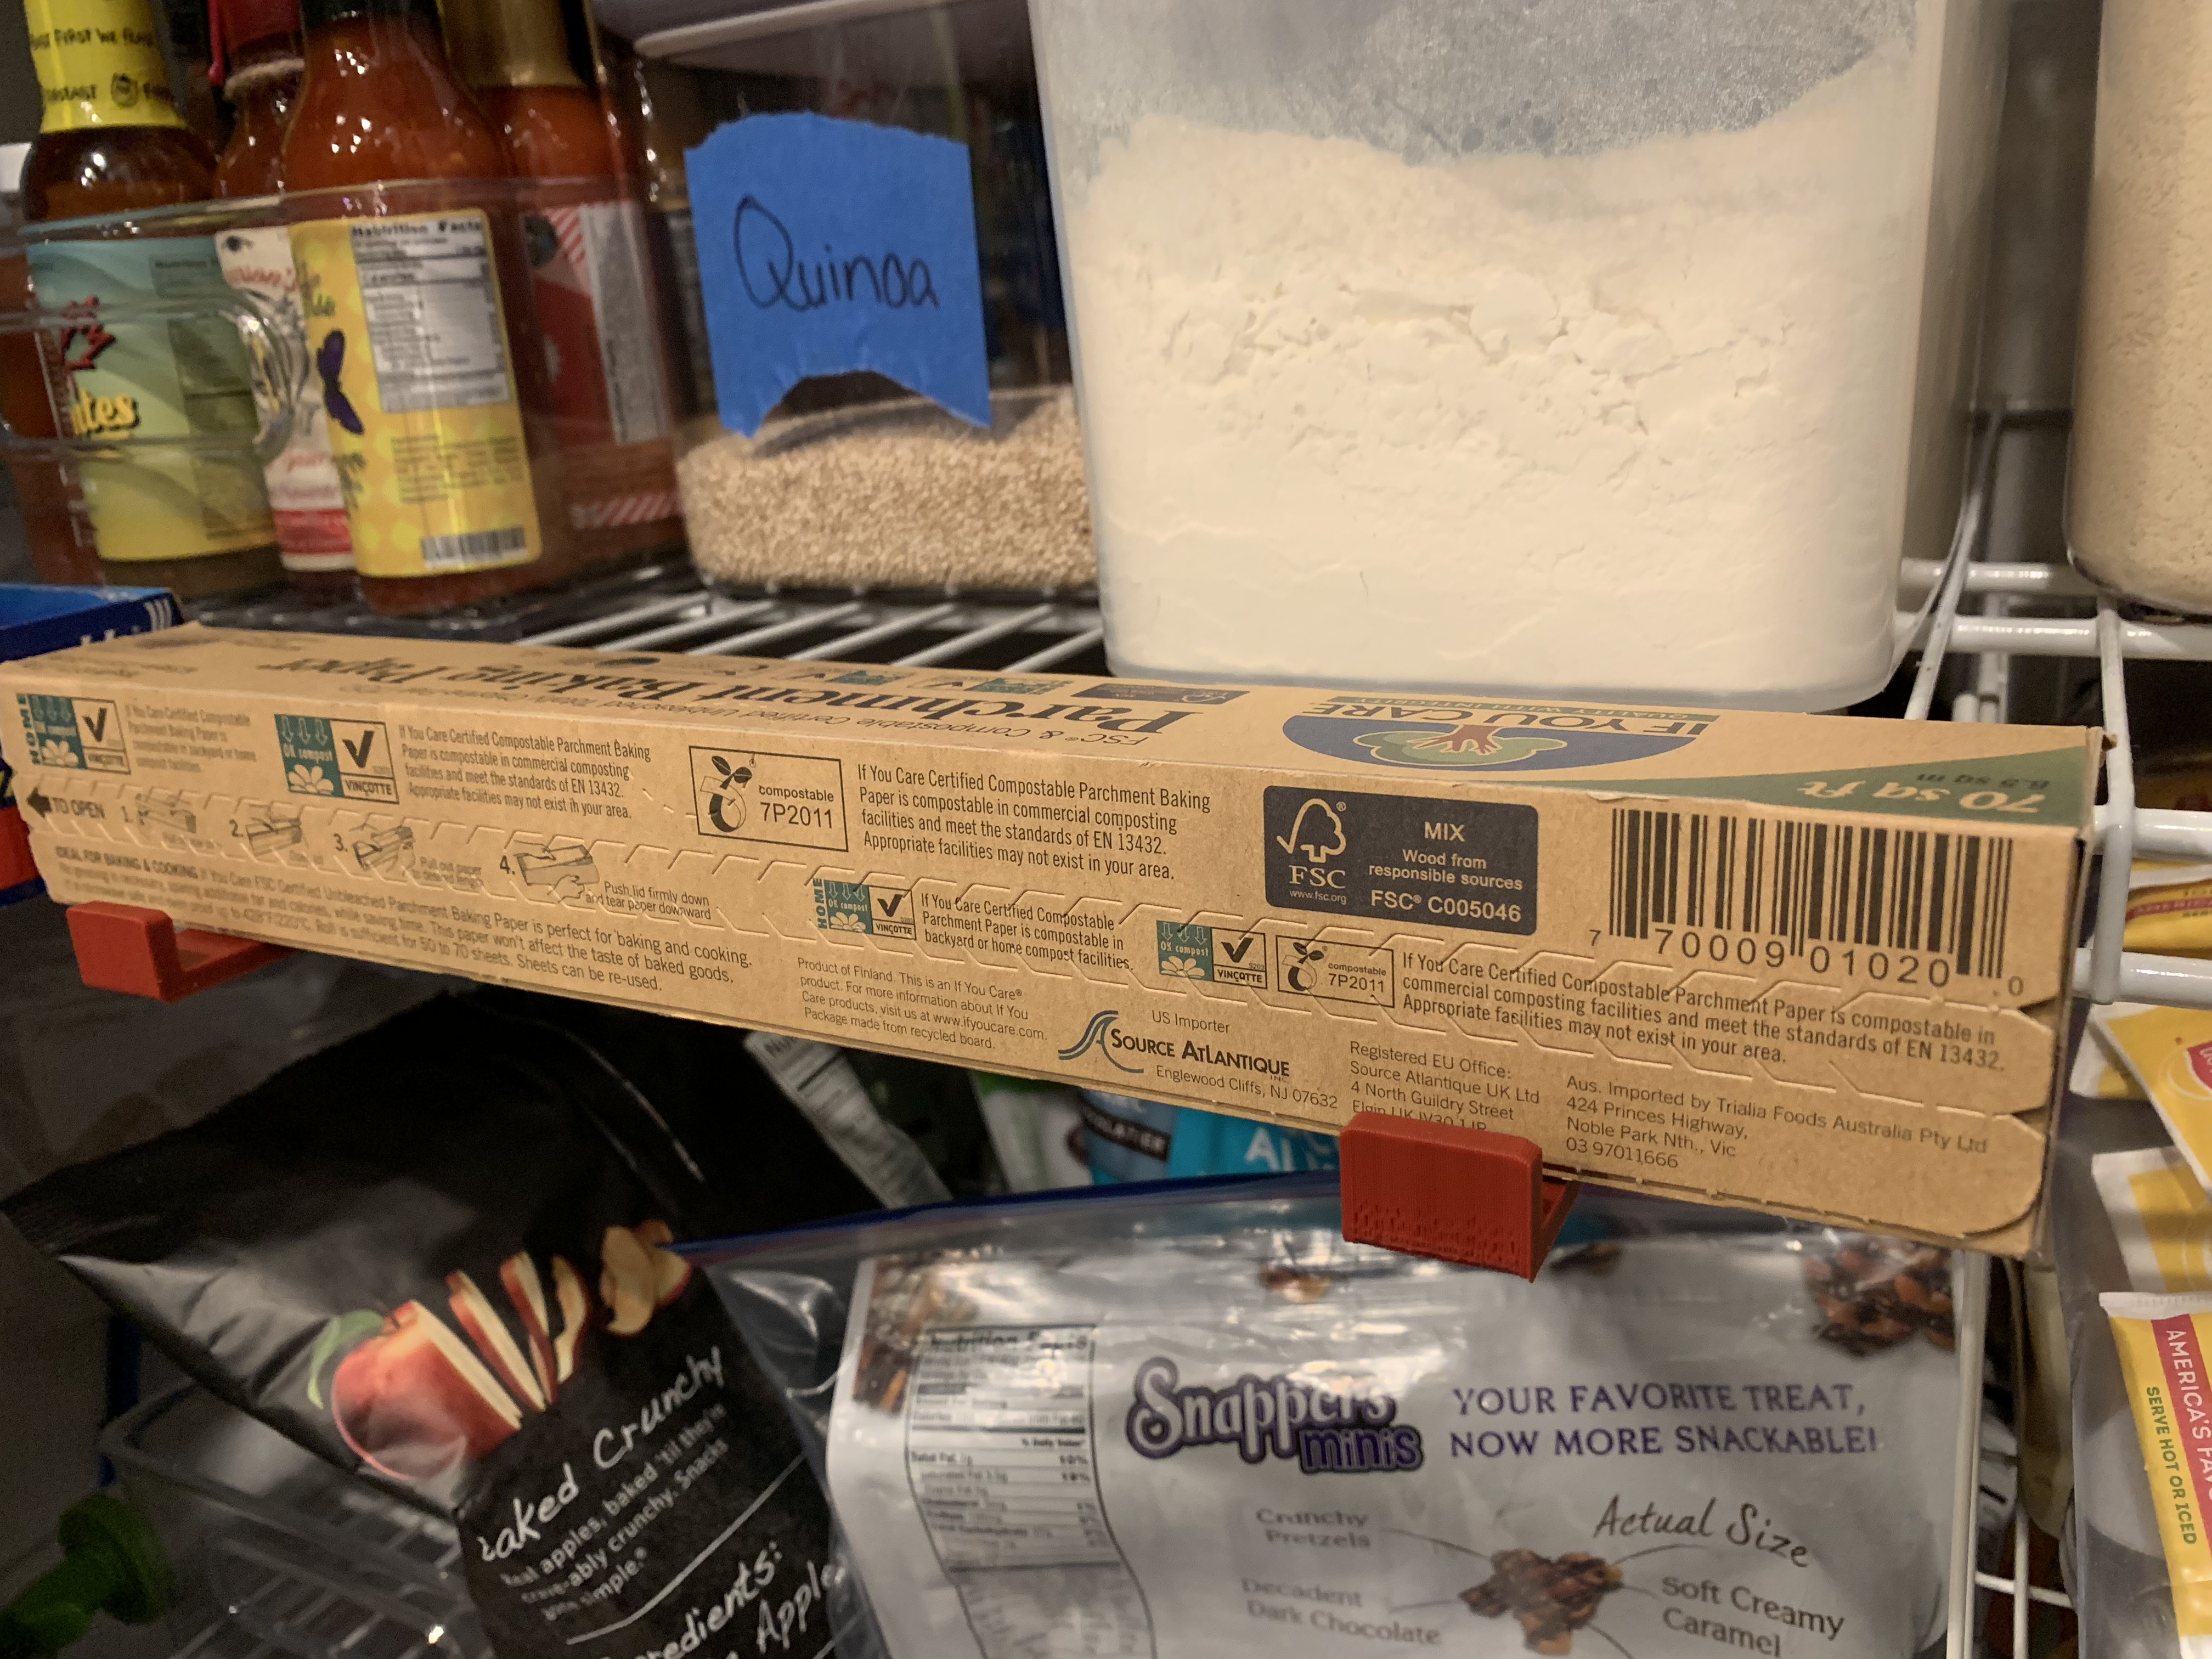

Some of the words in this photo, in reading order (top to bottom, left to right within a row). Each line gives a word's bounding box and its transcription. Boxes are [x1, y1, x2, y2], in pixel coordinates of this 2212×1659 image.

[733, 193, 939, 313] Quinoa
[256, 657, 450, 684] Paper
[439, 665, 706, 702] Baking
[693, 684, 1201, 734] Parchment
[1354, 697, 1483, 709] INTEGRITY
[1494, 704, 1559, 713] WITH
[1577, 708, 1689, 719] QUALITY
[745, 710, 851, 725] Certified
[856, 718, 1031, 737] Compostable
[1487, 714, 1631, 731] YOU
[1640, 719, 1708, 735] IF
[1040, 730, 1063, 740] &
[758, 785, 834, 802] compostable
[857, 763, 867, 781] If
[868, 764, 893, 783] You
[895, 766, 926, 787] Care
[927, 768, 985, 792] Certified
[988, 773, 1076, 799] Compostable
[1078, 781, 1156, 806] Parchment
[1159, 787, 1211, 815] Baking
[1796, 779, 1868, 798] ft
[1874, 780, 1951, 803] sq
[1959, 790, 2047, 814] 70
[52, 797, 67, 814] TO
[70, 799, 105, 819] OPEN
[760, 802, 833, 829] 7P2011
[859, 785, 896, 808] Paper
[897, 788, 910, 808] is
[911, 794, 995, 815] compostable
[996, 797, 1010, 817] in
[1012, 803, 1091, 825] commercial
[1094, 810, 1178, 836] composting
[229, 819, 244, 839] 2.
[333, 833, 348, 853] 3.
[860, 807, 916, 831] facilities
[917, 815, 942, 833] and
[945, 819, 978, 837] meet
[979, 819, 1002, 839] the
[1005, 822, 1073, 846] standards
[1075, 829, 1090, 848] of
[1092, 830, 1113, 850] EN
[1118, 832, 1167, 856] 13432.
[1424, 821, 1466, 843] MIX
[499, 855, 515, 875] 4.
[863, 830, 936, 855] Appropriate
[937, 837, 994, 861] facilities
[996, 848, 1025, 868] may
[1027, 849, 1050, 867] not
[1052, 853, 1085, 871] exist
[1087, 852, 1102, 873] in
[1103, 859, 1135, 877] your
[1138, 862, 1175, 881] area.
[1402, 848, 1447, 866] Wood
[1451, 853, 1487, 870] from
[1289, 865, 1347, 889] FSC
[1369, 865, 1455, 884] responsible
[1460, 872, 1523, 891] sources
[585, 892, 603, 905] and
[606, 896, 625, 908] tear
[628, 899, 656, 917] paper
[659, 902, 712, 920] downward
[604, 881, 629, 896] Push
[632, 884, 646, 899] lid
[648, 886, 678, 905] firmly
[681, 891, 710, 906] down
[812, 877, 827, 929] HOME
[828, 898, 838, 909] OK
[840, 900, 868, 913] compost
[1290, 889, 1347, 905] www.fsc.org
[1427, 895, 1522, 923] C005046
[875, 922, 913, 936] VINÇOTTE
[1160, 940, 1172, 952] OK
[1175, 944, 1209, 957] compost
[1589, 929, 1601, 946] 7
[1654, 928, 1785, 968] 70009
[1810, 945, 1950, 988] 01020
[2008, 976, 2024, 996] 0
[1217, 968, 1263, 983] VINÇOTTE
[1327, 961, 1387, 977] compostable
[1328, 973, 1384, 992] 7P2011
[1152, 1009, 1171, 1024] US
[1175, 1013, 1230, 1034] Importer
[1111, 1028, 1175, 1058] SOURCE
[1350, 1040, 1427, 1066] Registered
[1432, 1053, 1455, 1070] EU
[1458, 1057, 1512, 1080] Office:
[1156, 1065, 1226, 1088] Englewood
[1229, 1077, 1266, 1098] Cliffs,
[1270, 1085, 1288, 1099] NJ
[1292, 1090, 1338, 1109] 07632
[1350, 1059, 1402, 1082] Source
[1404, 1069, 1482, 1096] Atlantique
[1486, 1082, 1511, 1100] UK
[1515, 1086, 1541, 1105] Ltd
[1350, 1080, 1361, 1094] 4
[1365, 1082, 1407, 1103] North
[1410, 1090, 1465, 1115] Guildry
[1468, 1099, 1515, 1121] Street
[1566, 1074, 1601, 1094] Aus.
[1608, 1080, 1685, 1107] Imported
[1690, 1093, 1712, 1113] by
[1716, 1096, 1768, 1120] Trialia
[1773, 1105, 1827, 1129] Foods
[1832, 1114, 1913, 1142] Australia
[1919, 1127, 1952, 1151] Pty
[1956, 1134, 1988, 1154] Ltd
[1565, 1096, 1599, 1114] 424
[1603, 1101, 1666, 1125] Princes
[1671, 1111, 1748, 1141] Highway,
[1566, 1115, 1616, 1138] Noble
[1620, 1124, 1659, 1146] Park
[1663, 1131, 1705, 1155] Nth.,
[1709, 1138, 1737, 1158] Vic
[1565, 1136, 1589, 1154] 03
[1592, 1141, 1679, 1169] 97011666
[2166, 1329, 2211, 1440] AMERICA'S
[593, 1346, 725, 1470] Crunchy
[1126, 1356, 1397, 1464] Snappers
[1453, 1387, 1555, 1415] YOUR
[1571, 1383, 1738, 1414] FAVORITE
[1743, 1384, 1866, 1416] TREAT,
[2146, 1386, 2170, 1435] SERVE
[1299, 1425, 1424, 1475] minis
[1450, 1430, 1538, 1458] NOW
[1554, 1427, 1662, 1457] MORE
[1676, 1425, 1877, 1455] SNACKABLE!
[2159, 1438, 2180, 1471] HOT
[2169, 1475, 2186, 1499] OR
[540, 1514, 607, 1575] apples,
[603, 1462, 661, 1517] baked
[608, 1487, 679, 1552] crunchy.
[1255, 1508, 1370, 1528] Crunchy
[1593, 1494, 1716, 1538] Actual
[1726, 1503, 1810, 1568] Size
[2175, 1503, 2197, 1544] ICED
[1265, 1528, 1371, 1549] Pretzels
[1241, 1577, 1363, 1609] Decadent
[1246, 1599, 1305, 1625] Dark
[1309, 1611, 1442, 1646] Chocolate
[1662, 1576, 1720, 1606] Soft
[1730, 1587, 1846, 1642] Creamy
[1662, 1607, 1781, 1658] Caramel
